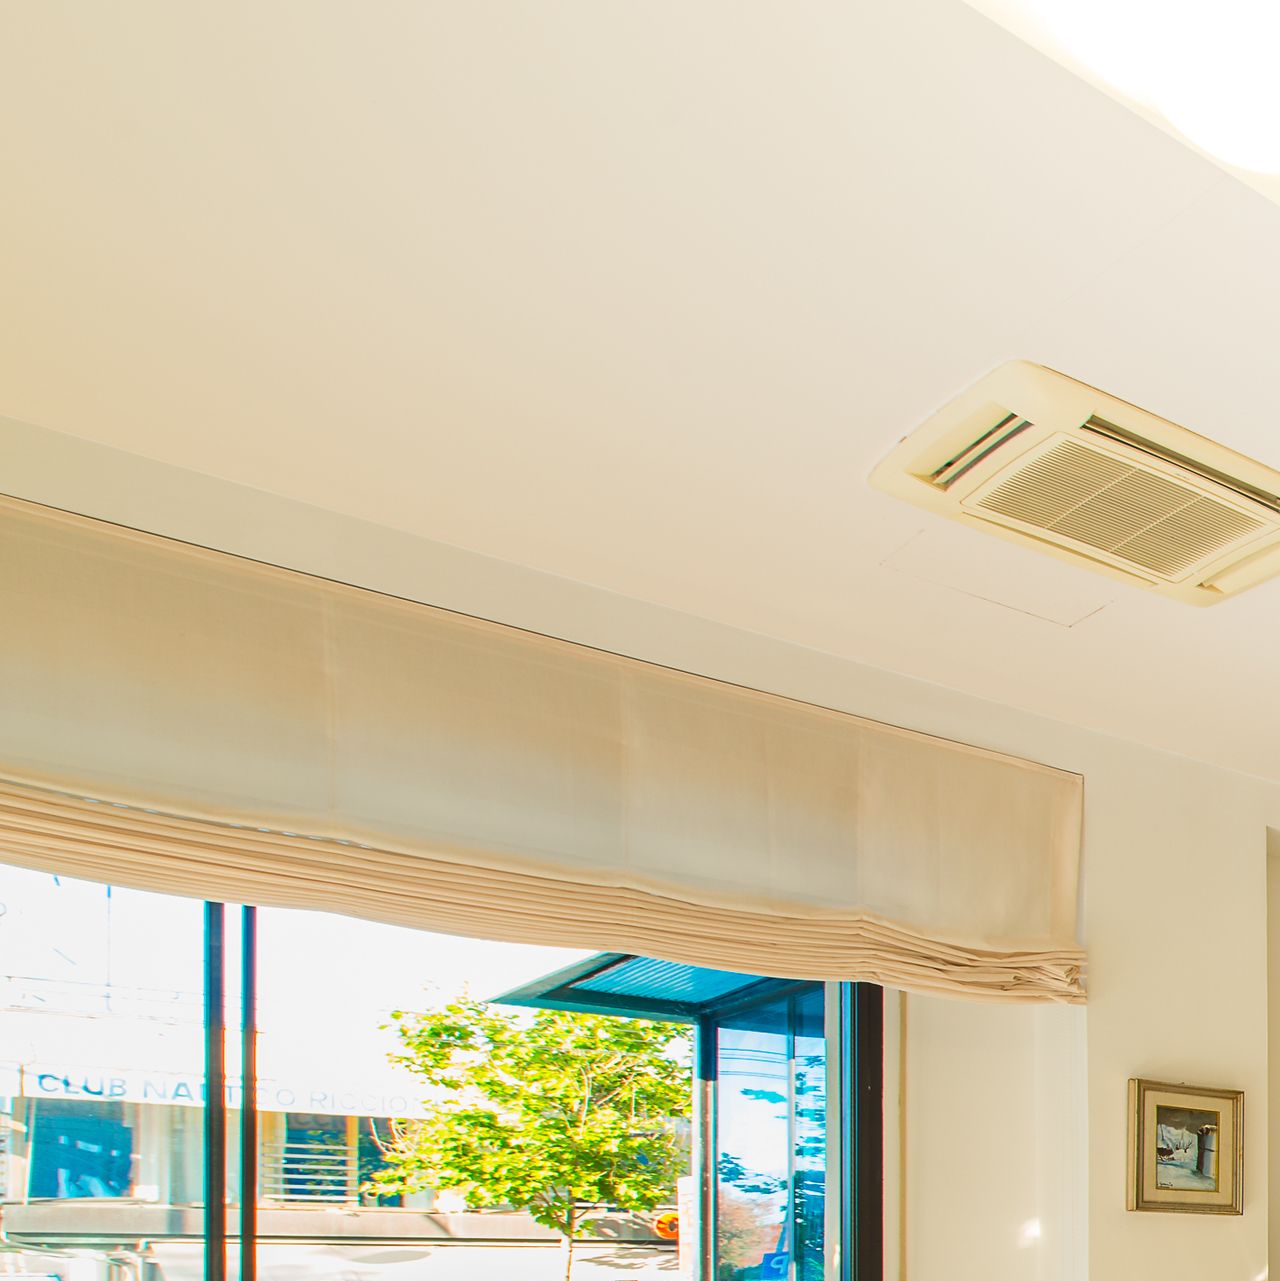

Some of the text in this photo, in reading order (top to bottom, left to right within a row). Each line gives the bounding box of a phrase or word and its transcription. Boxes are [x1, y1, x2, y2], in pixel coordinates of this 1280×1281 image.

[37, 1073, 446, 1114] CLUB NATO RICCIO
